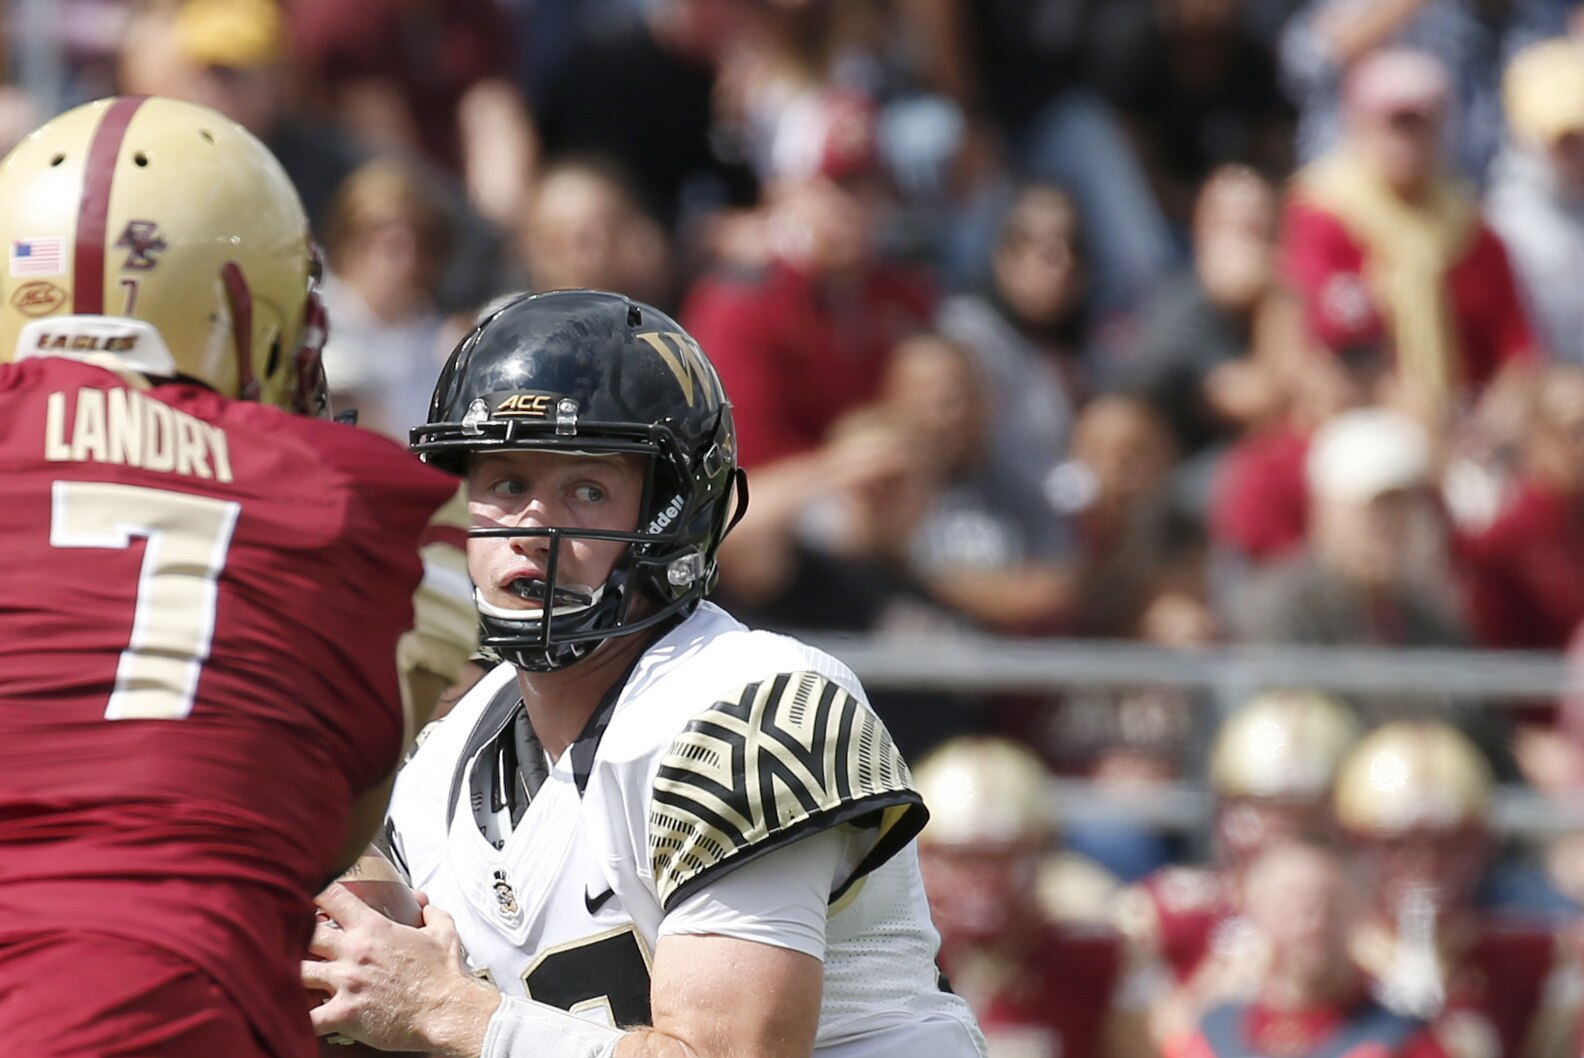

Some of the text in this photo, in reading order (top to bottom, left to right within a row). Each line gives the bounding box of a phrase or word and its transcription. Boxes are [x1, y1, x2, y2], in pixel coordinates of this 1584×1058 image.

[120, 279, 139, 317] 7
[44, 386, 233, 483] LANDRY
[496, 394, 552, 411] ACC
[49, 480, 242, 721] 7
